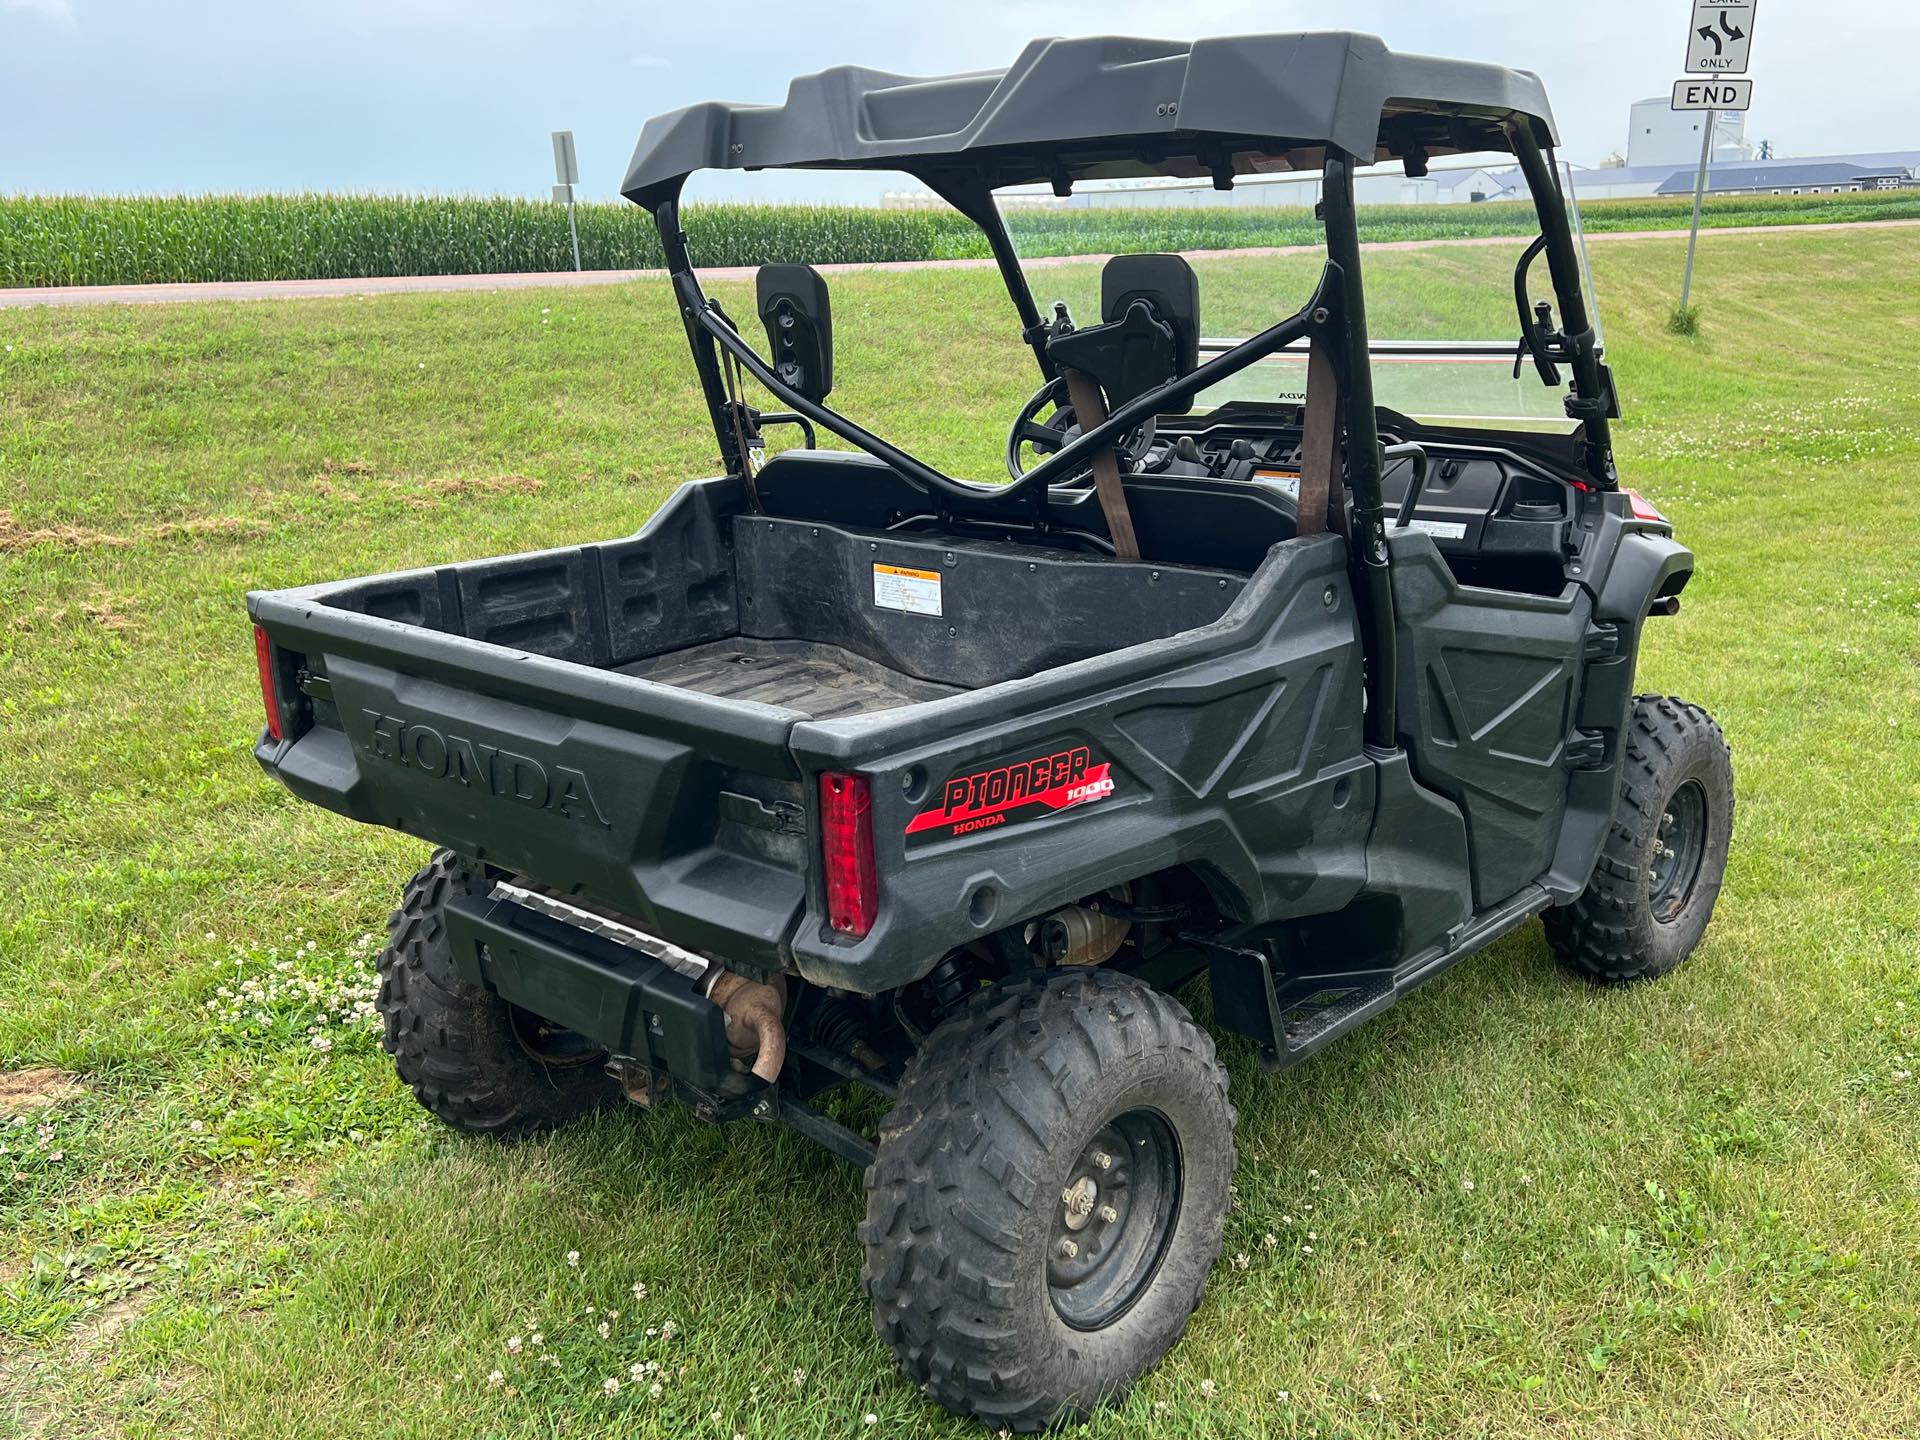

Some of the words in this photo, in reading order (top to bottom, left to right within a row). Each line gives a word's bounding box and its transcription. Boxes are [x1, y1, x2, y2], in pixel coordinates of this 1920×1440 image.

[1700, 58, 1733, 68] ONLY
[1686, 86, 1737, 104] END
[361, 708, 612, 831] HONDA
[943, 746, 1090, 818] PIONEER
[1066, 779, 1115, 800] 1000
[952, 813, 1006, 836] HONDA
